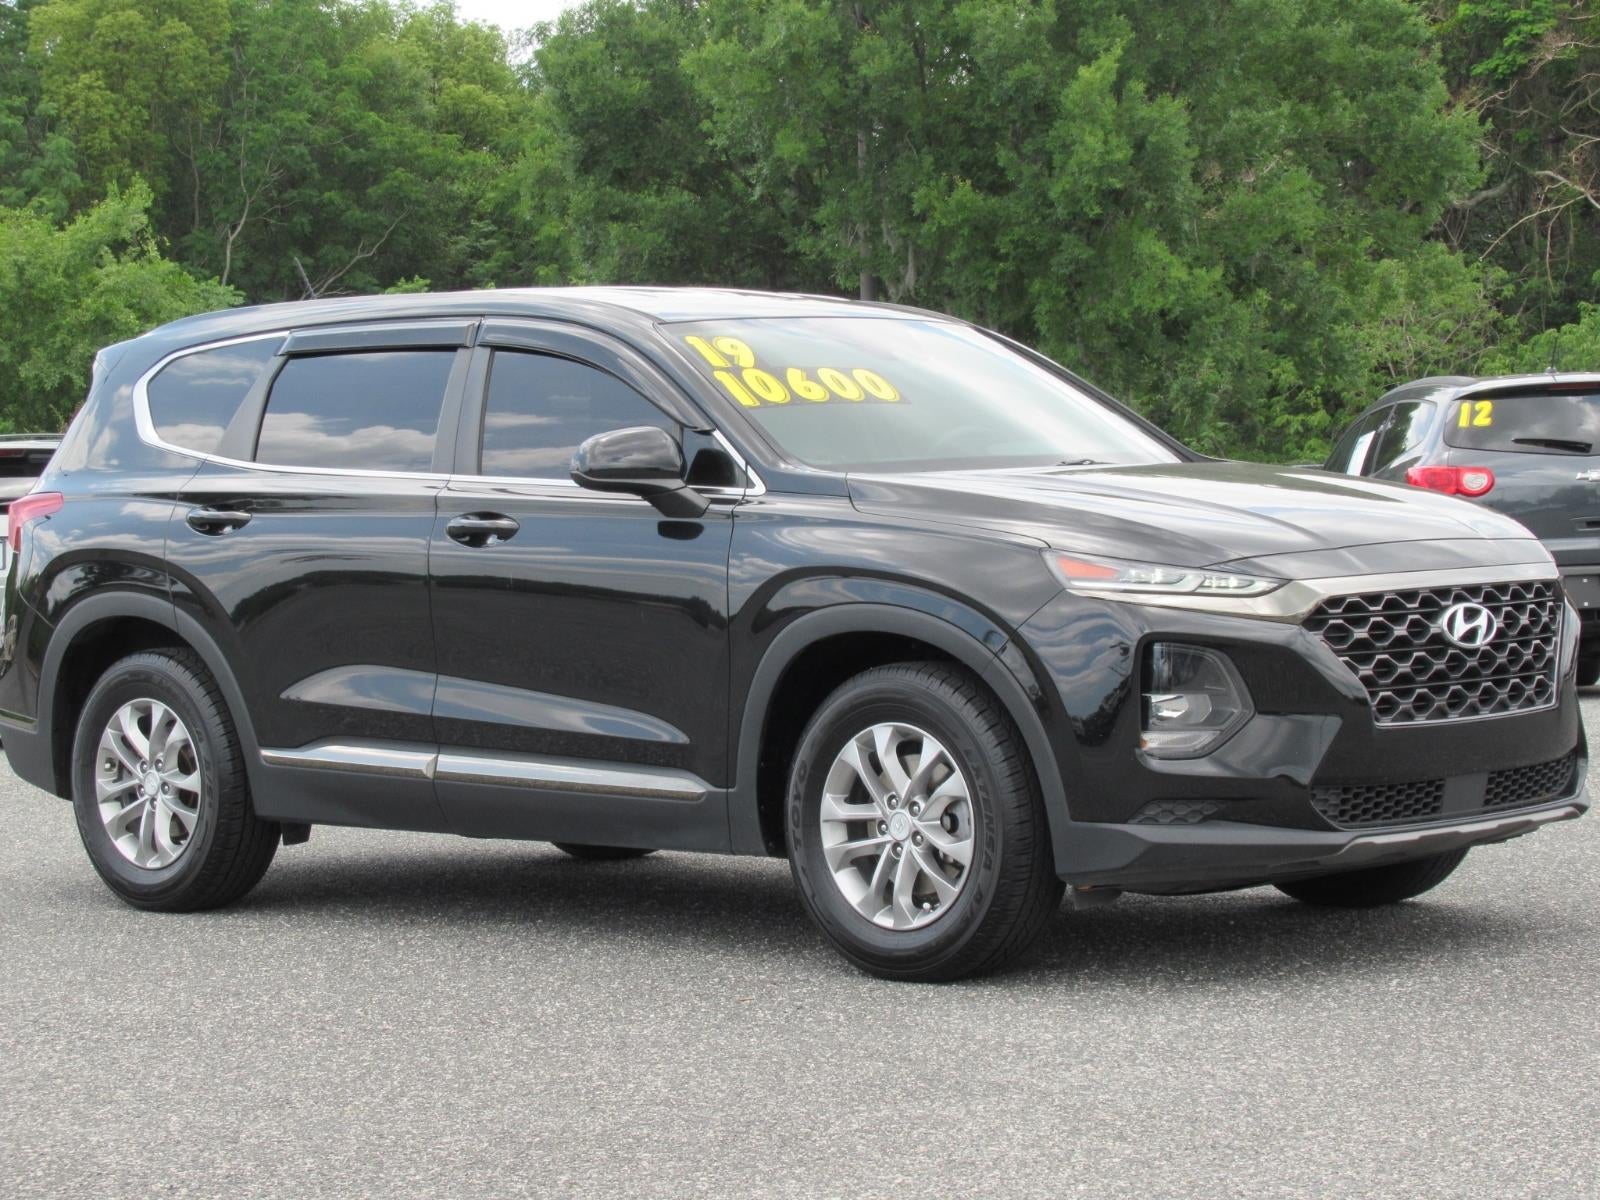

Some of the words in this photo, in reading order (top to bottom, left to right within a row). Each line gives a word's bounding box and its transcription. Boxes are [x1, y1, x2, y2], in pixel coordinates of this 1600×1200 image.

[684, 336, 756, 368] 19
[713, 367, 900, 407] 10600
[1458, 400, 1494, 428] 12
